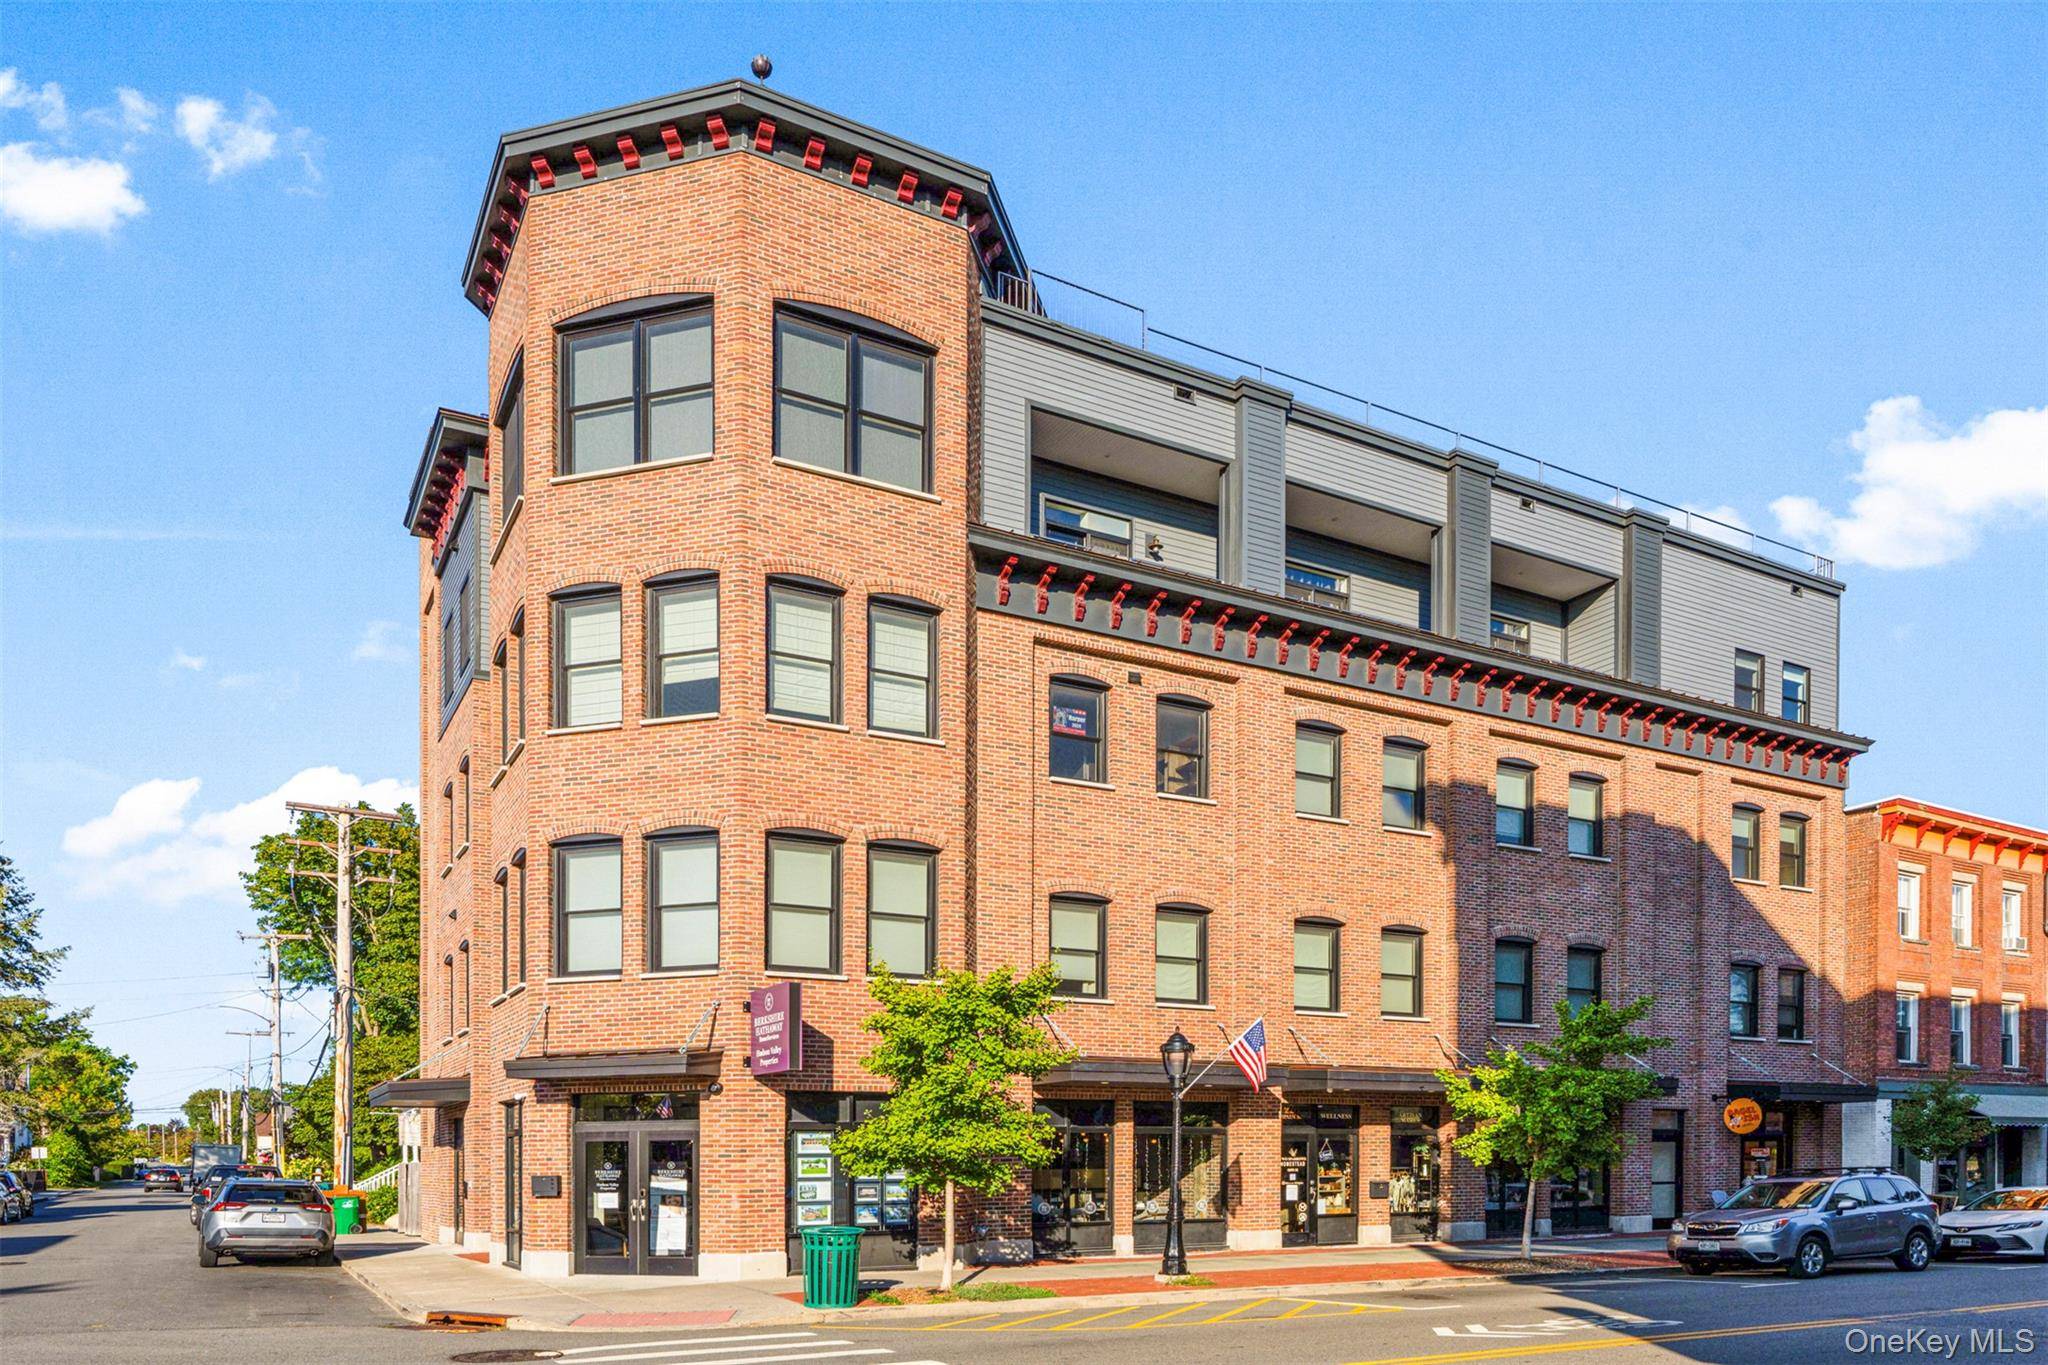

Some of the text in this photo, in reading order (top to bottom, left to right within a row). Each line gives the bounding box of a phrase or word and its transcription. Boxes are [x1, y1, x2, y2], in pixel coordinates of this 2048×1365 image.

[753, 1011, 785, 1027] BERKSHIRE
[755, 1022, 784, 1037] HATHAWAY
[756, 1045, 782, 1058] Hudson Valley
[759, 1056, 779, 1068] Properties
[1320, 1112, 1353, 1120] WELLNESS
